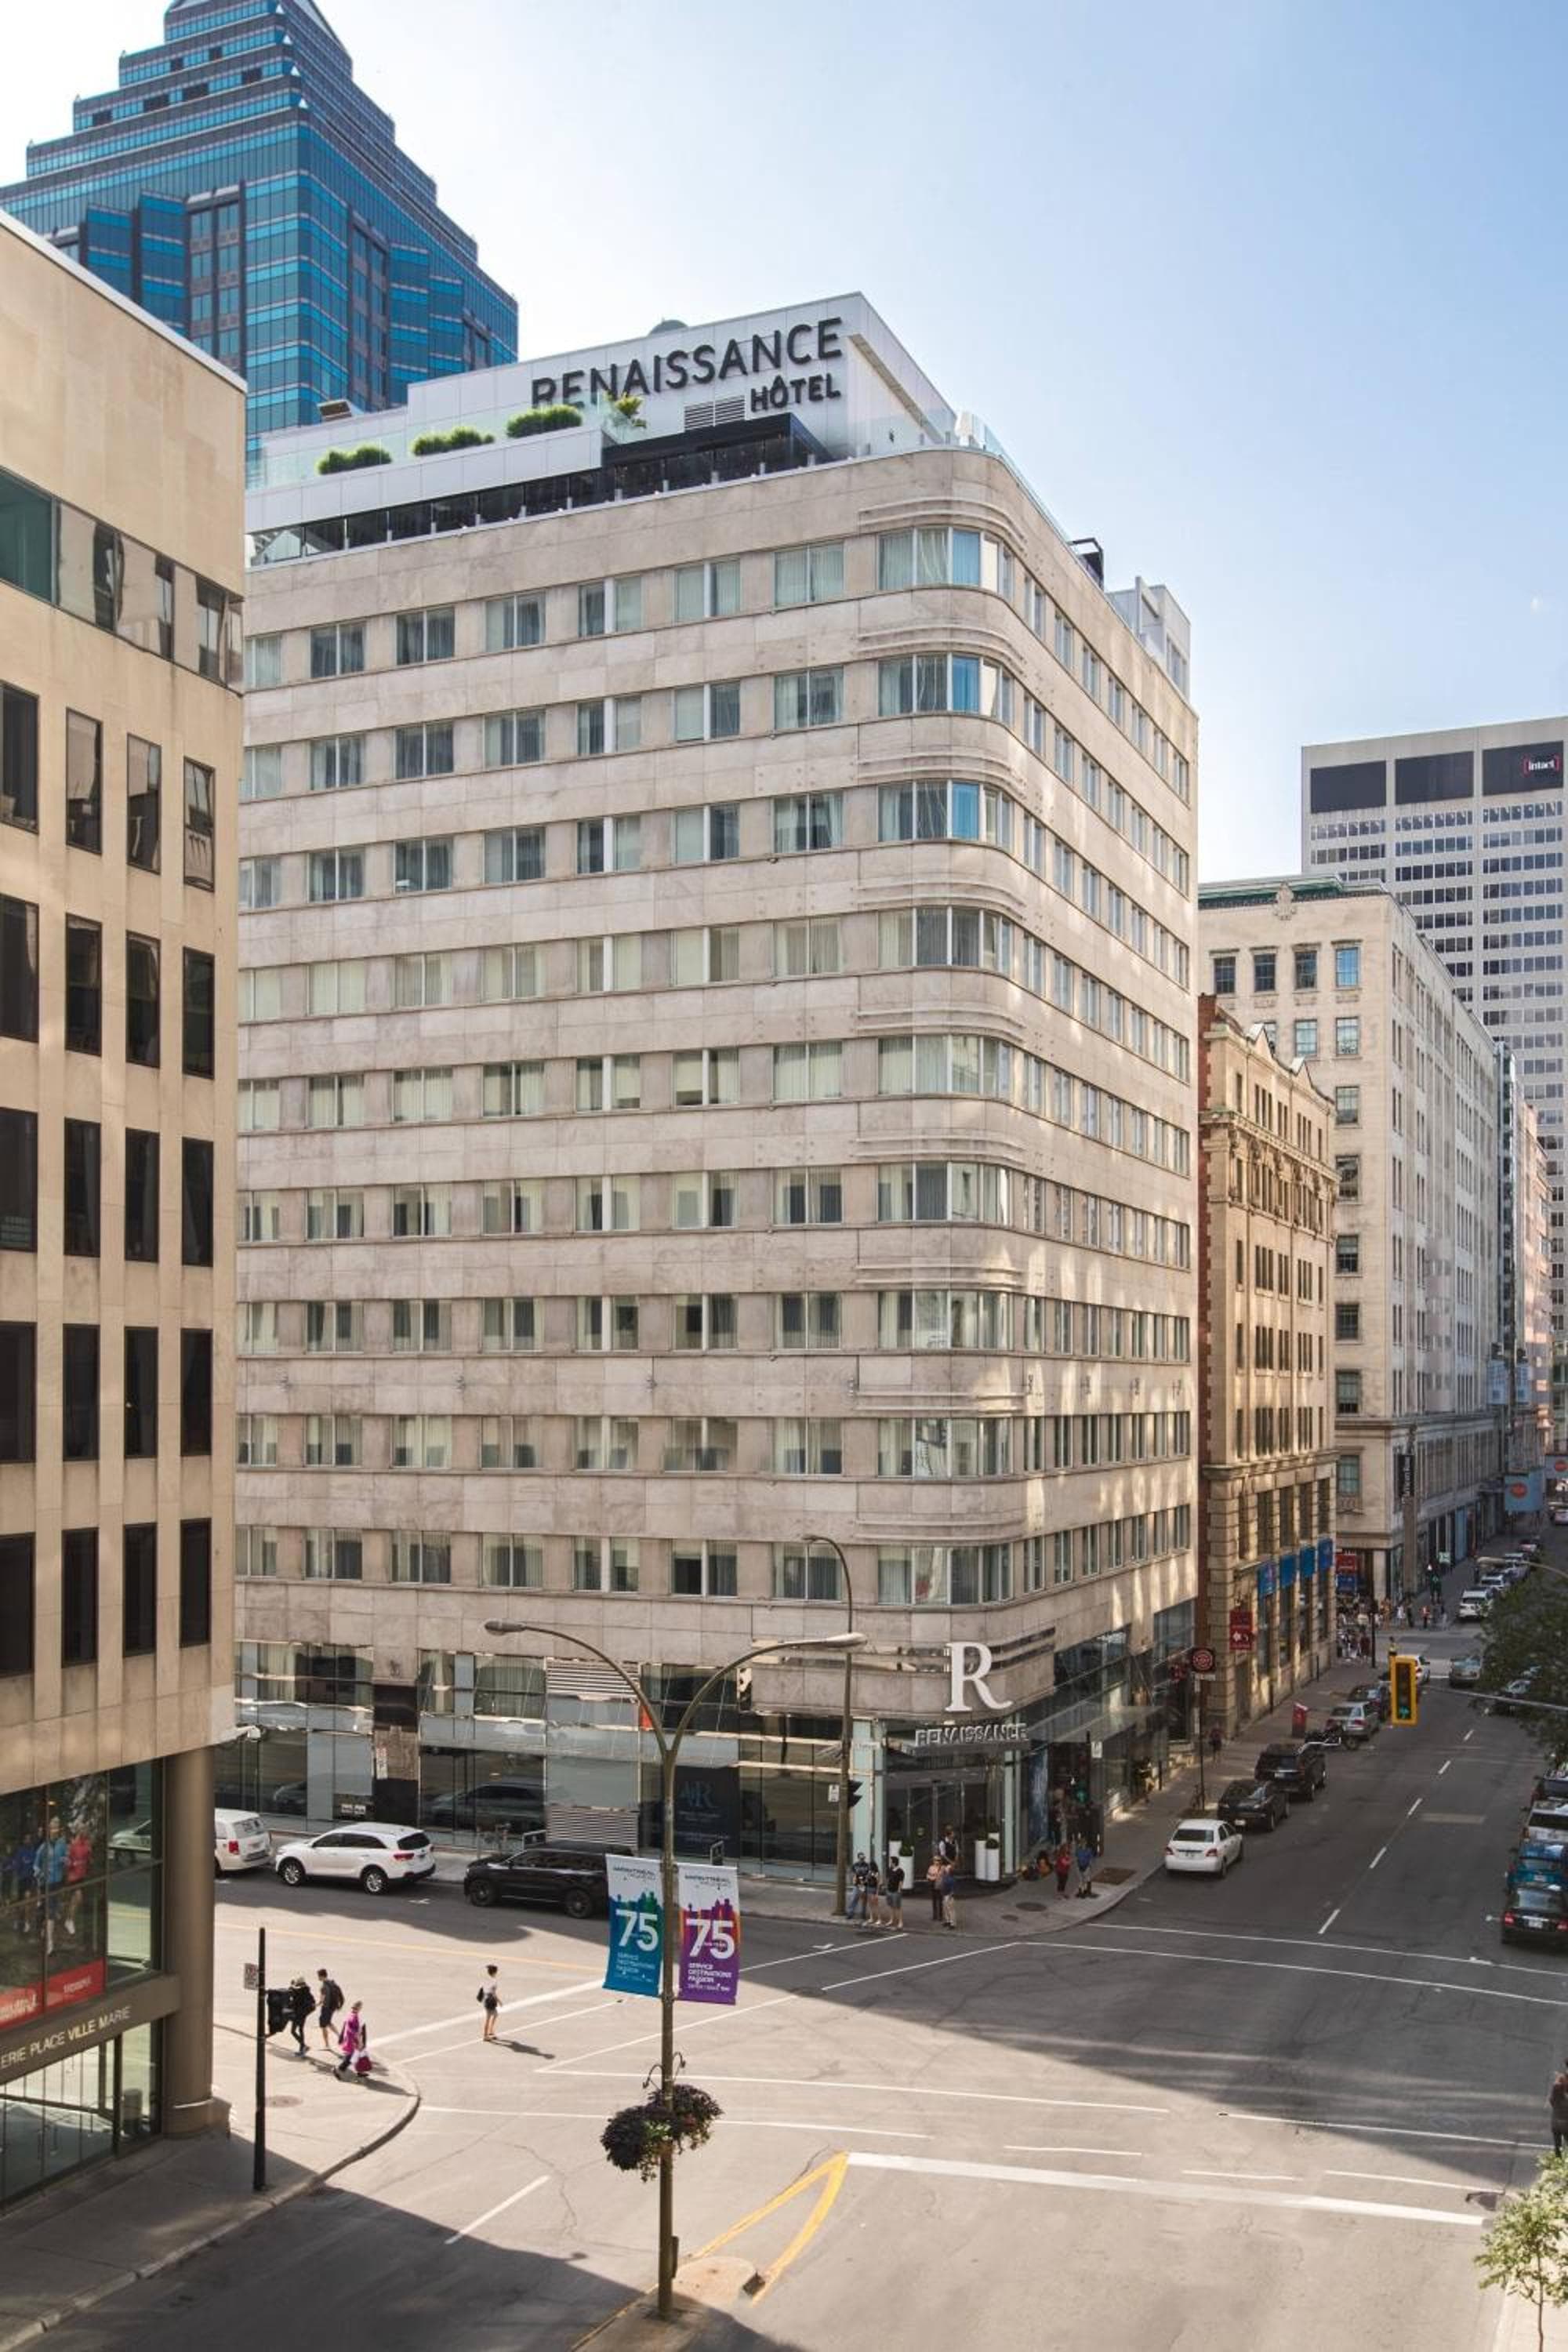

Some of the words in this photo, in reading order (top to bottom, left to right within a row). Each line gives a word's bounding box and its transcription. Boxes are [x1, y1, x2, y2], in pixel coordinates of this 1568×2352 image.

[531, 318, 843, 409] RENAISSANCE
[750, 373, 840, 412] HÔTEL
[945, 1641, 1014, 1712] R
[915, 1722, 1029, 1747] RENAISSANCE
[616, 1910, 658, 1951] 75
[686, 1918, 735, 1959] 75
[30, 2032, 65, 2056] PLACE
[67, 2019, 96, 2041] VILLE
[98, 2005, 131, 2030] MARIE
